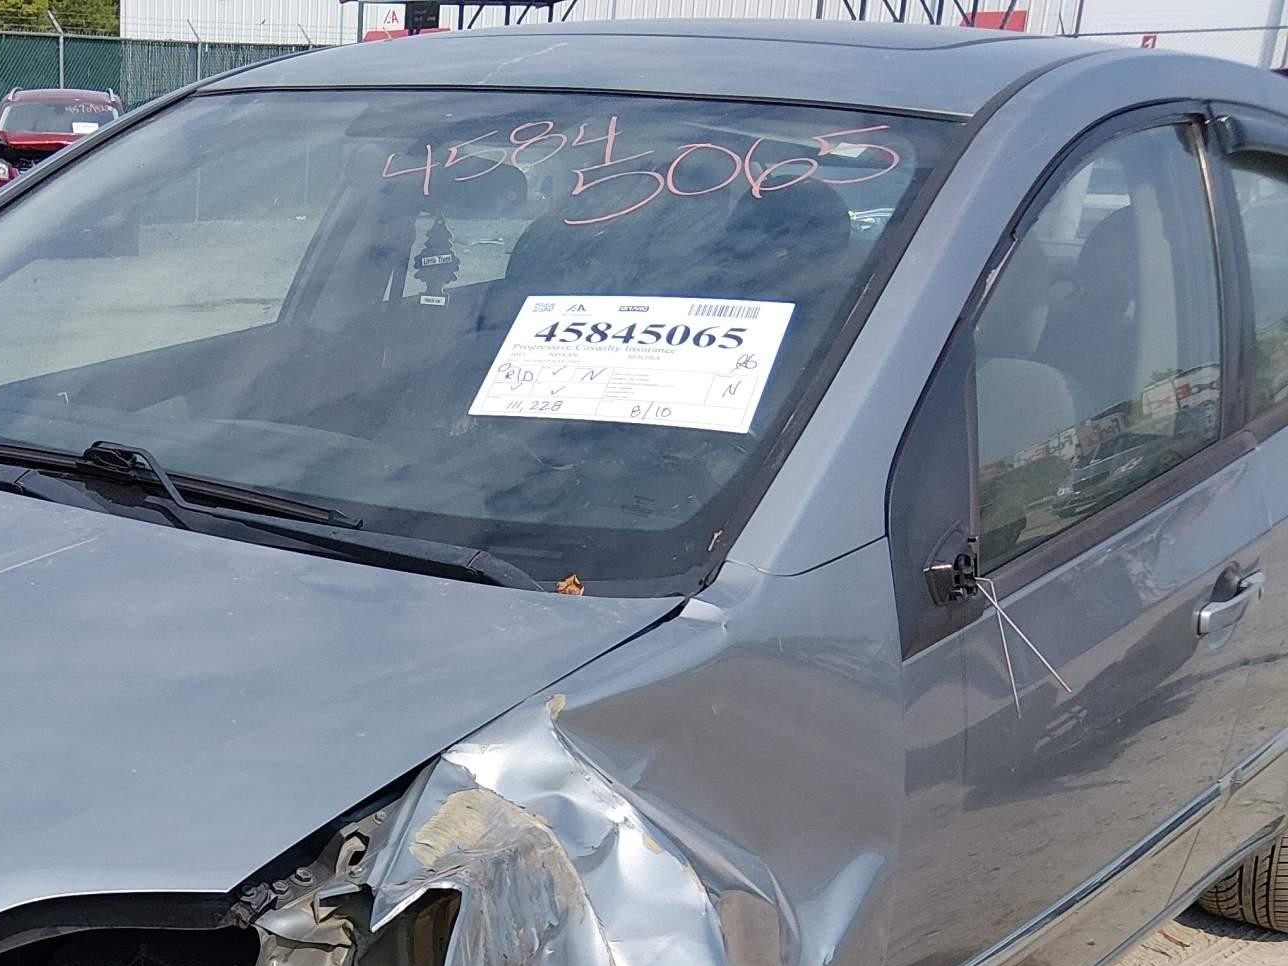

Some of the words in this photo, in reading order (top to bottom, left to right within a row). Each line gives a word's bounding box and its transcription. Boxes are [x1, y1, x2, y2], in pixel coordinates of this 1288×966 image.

[382, 116, 623, 195] 4584
[564, 125, 900, 225] 5065
[533, 321, 749, 349] 45845065
[625, 345, 677, 354] Insurance
[630, 401, 672, 420] 8/10
